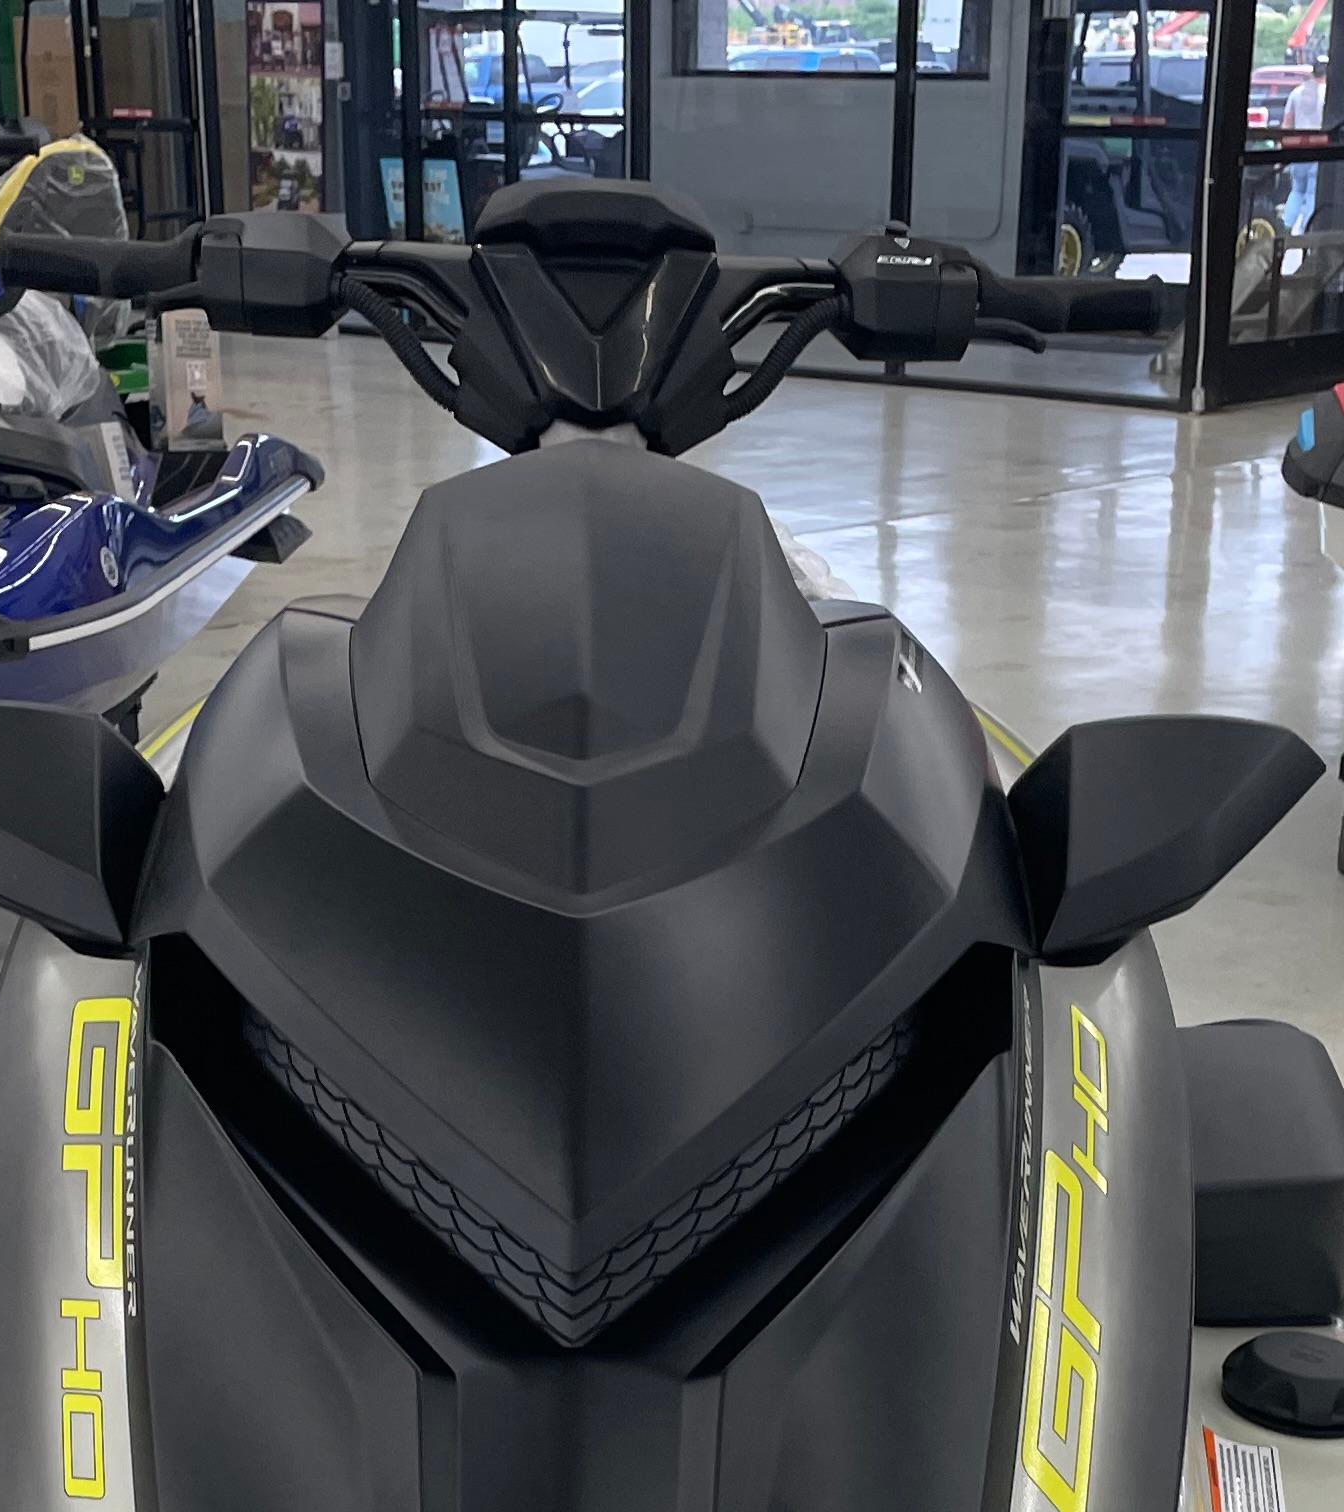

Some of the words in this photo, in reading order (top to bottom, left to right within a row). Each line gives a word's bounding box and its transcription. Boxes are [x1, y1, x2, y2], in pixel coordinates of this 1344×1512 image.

[62, 997, 134, 1289] GP
[1071, 1004, 1110, 1197] HO
[60, 1298, 106, 1500] HO
